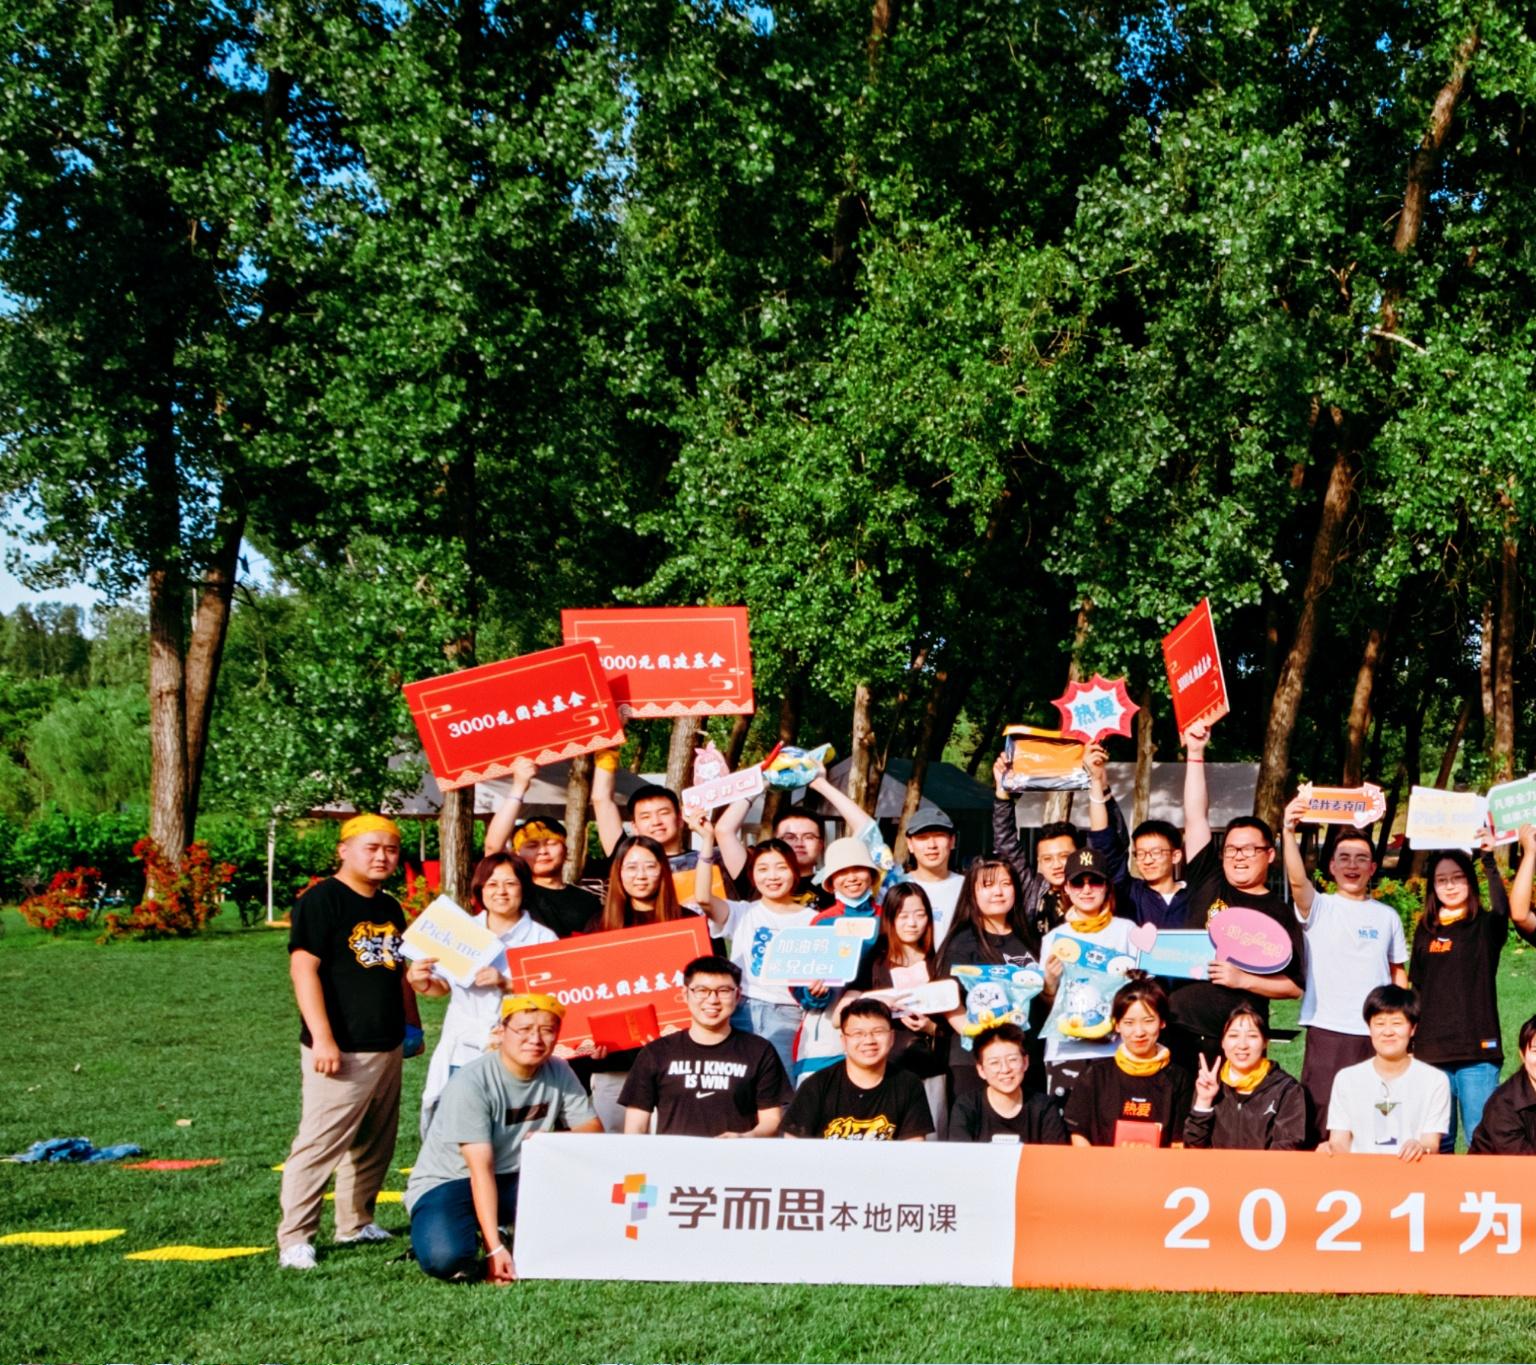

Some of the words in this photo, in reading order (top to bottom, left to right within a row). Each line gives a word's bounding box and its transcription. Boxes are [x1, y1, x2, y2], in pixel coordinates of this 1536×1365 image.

[447, 690, 587, 739] 3000元团建基金
[1072, 696, 1116, 728] 热爱
[668, 1060, 693, 1075] ALL
[704, 1061, 748, 1078] KNOW
[684, 1074, 698, 1089] IS
[700, 1075, 729, 1090] WIN
[1123, 1101, 1151, 1118] 热爱
